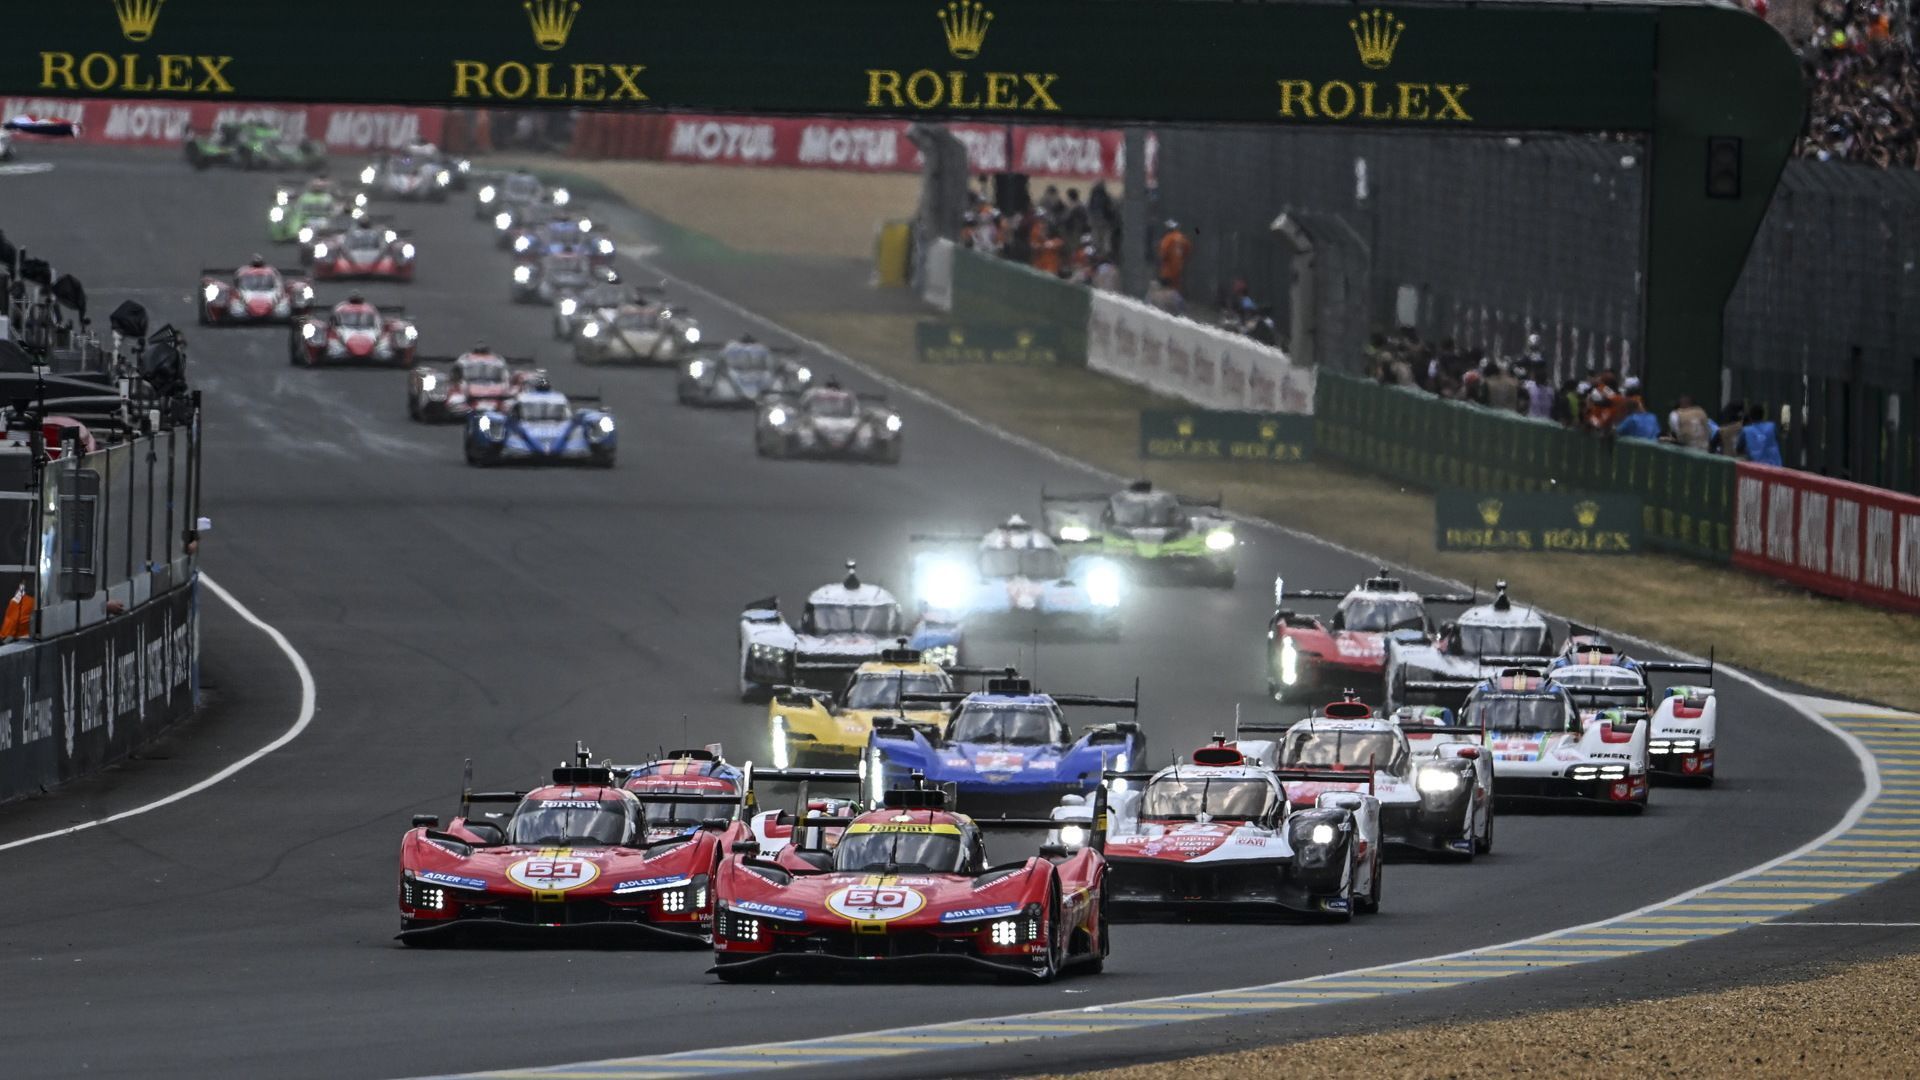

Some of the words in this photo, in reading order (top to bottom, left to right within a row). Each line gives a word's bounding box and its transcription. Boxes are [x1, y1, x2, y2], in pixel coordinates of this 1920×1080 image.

[40, 52, 234, 93] ROLEX
[453, 61, 647, 101] ROLEX
[866, 69, 1060, 110] ROLEX
[1278, 80, 1472, 121] ROLEX
[104, 104, 190, 139] MOTUL
[326, 112, 418, 147] MOTUL
[672, 121, 775, 158] MOTUL
[799, 124, 897, 166] MOTUL
[1024, 133, 1102, 173] MOTUL
[1446, 528, 1532, 549] ROLEX
[1543, 528, 1631, 551] ROLEX
[1662, 727, 1702, 735] PENSKE
[539, 800, 602, 809] Ferrari
[868, 823, 932, 832] Ferrari
[423, 871, 461, 883] ADLER
[527, 863, 579, 877] 51
[619, 878, 657, 889] ADLER
[974, 875, 1009, 893] RICHARD
[738, 901, 778, 913] ADLER
[848, 891, 904, 905] 50
[945, 907, 985, 919] ADLER
